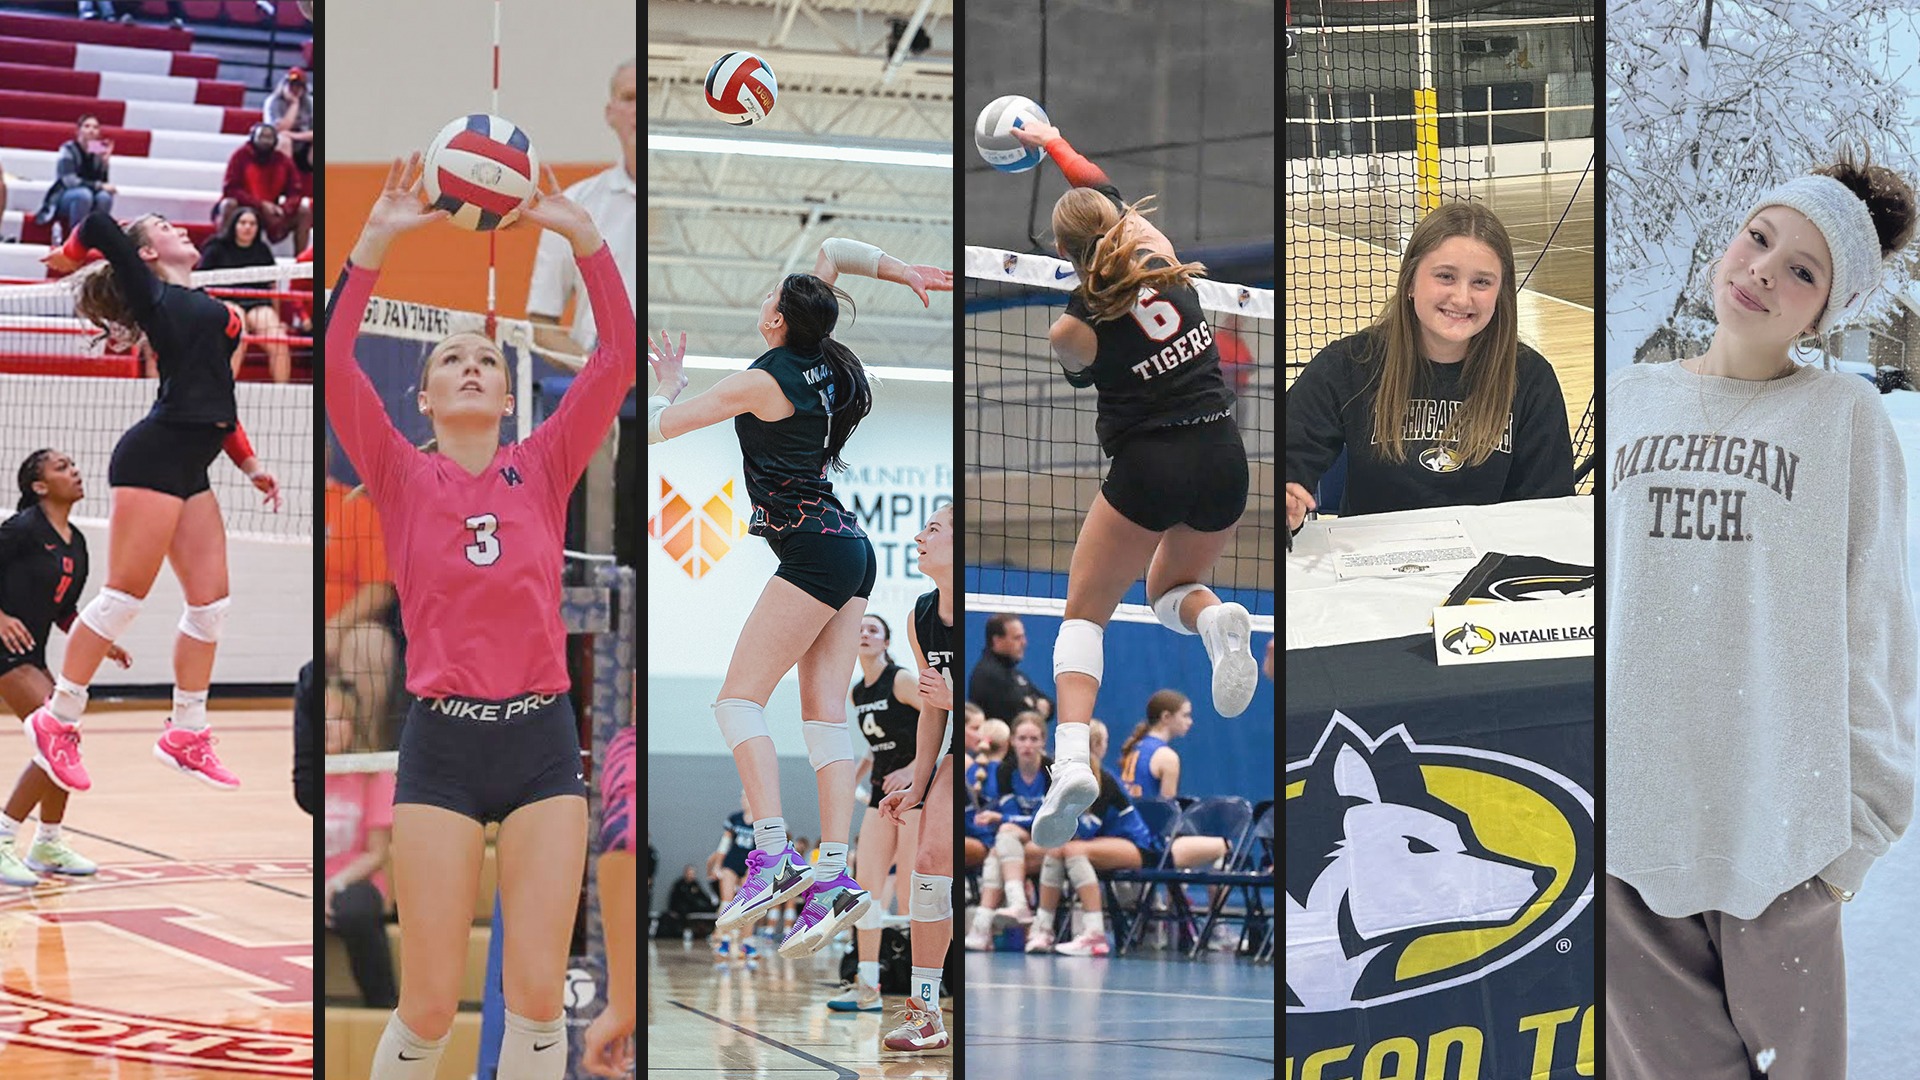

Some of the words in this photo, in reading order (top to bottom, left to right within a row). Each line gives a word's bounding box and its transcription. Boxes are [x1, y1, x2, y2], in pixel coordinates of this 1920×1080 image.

[383, 301, 450, 334] PANTHERS
[1129, 287, 1183, 342] 6
[1131, 320, 1213, 381] TIGERS
[1611, 434, 1800, 501] MICHIGAN
[464, 512, 501, 567] 3
[1648, 486, 1747, 541] TECH
[1500, 628, 1559, 644] NATALIE
[430, 699, 501, 722] NIKE
[504, 694, 557, 720] PRO
[862, 712, 886, 738] 4
